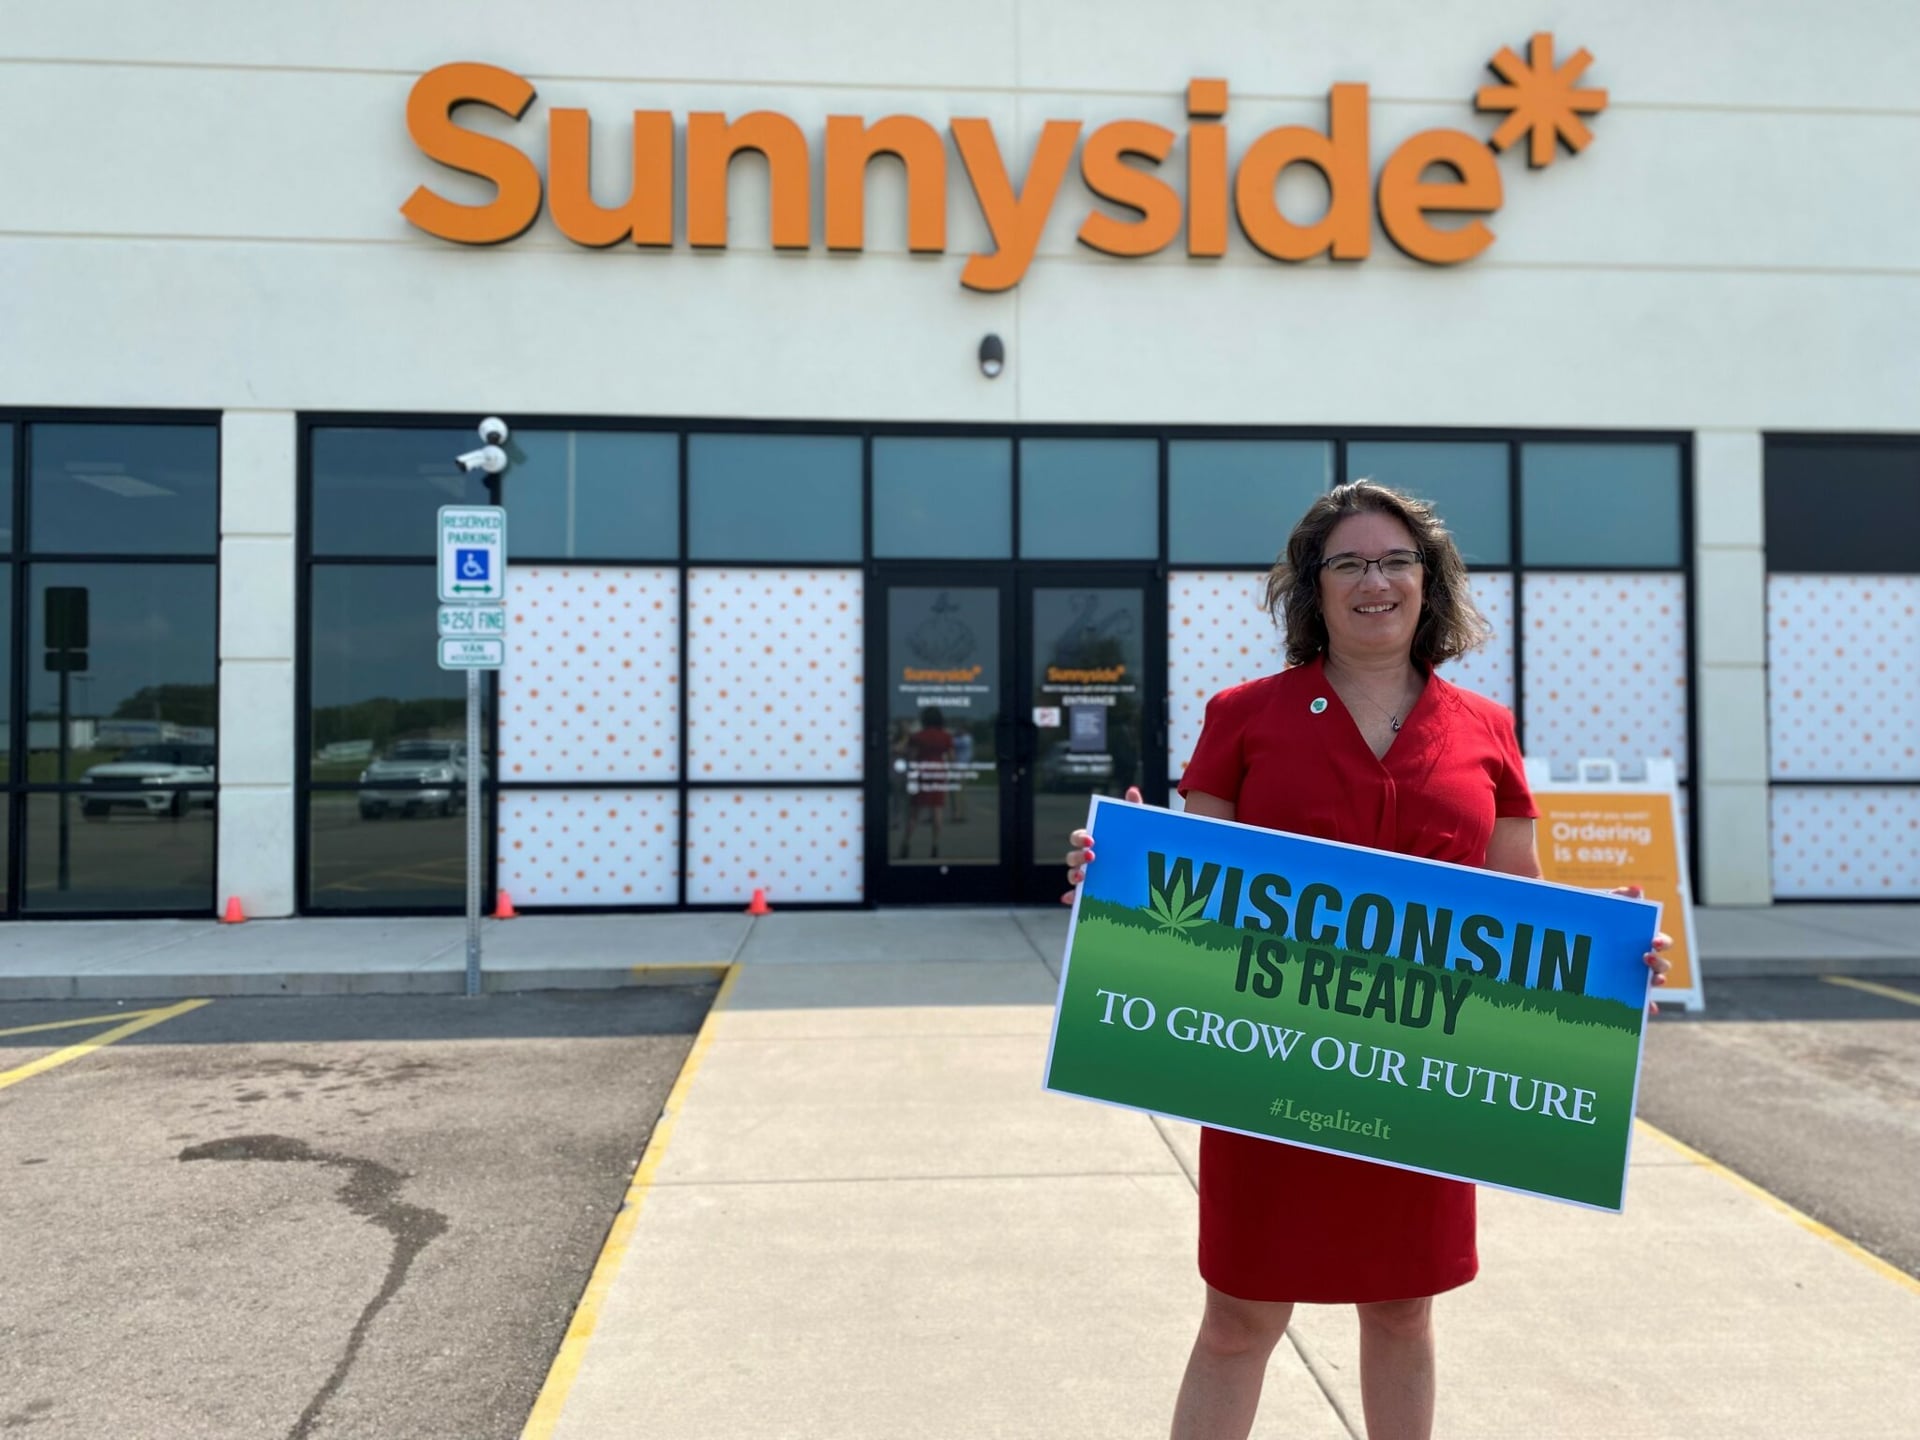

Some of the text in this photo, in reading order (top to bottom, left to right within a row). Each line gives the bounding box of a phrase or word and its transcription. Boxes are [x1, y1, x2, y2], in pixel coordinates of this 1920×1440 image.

[400, 60, 1504, 292] Sunnyside
[442, 516, 502, 529] RESERVED
[448, 532, 496, 544] PARKING
[478, 612, 504, 629] FINE
[461, 644, 485, 652] VAN
[1552, 822, 1652, 845] Ordering
[1554, 843, 1635, 865] is easy.
[1147, 851, 1592, 995] WISCONSIN
[1235, 936, 1472, 1035] IS READY
[1096, 989, 1597, 1125] TO GROW OUR FUTURE
[1269, 1097, 1391, 1141] #LegalizeIt
